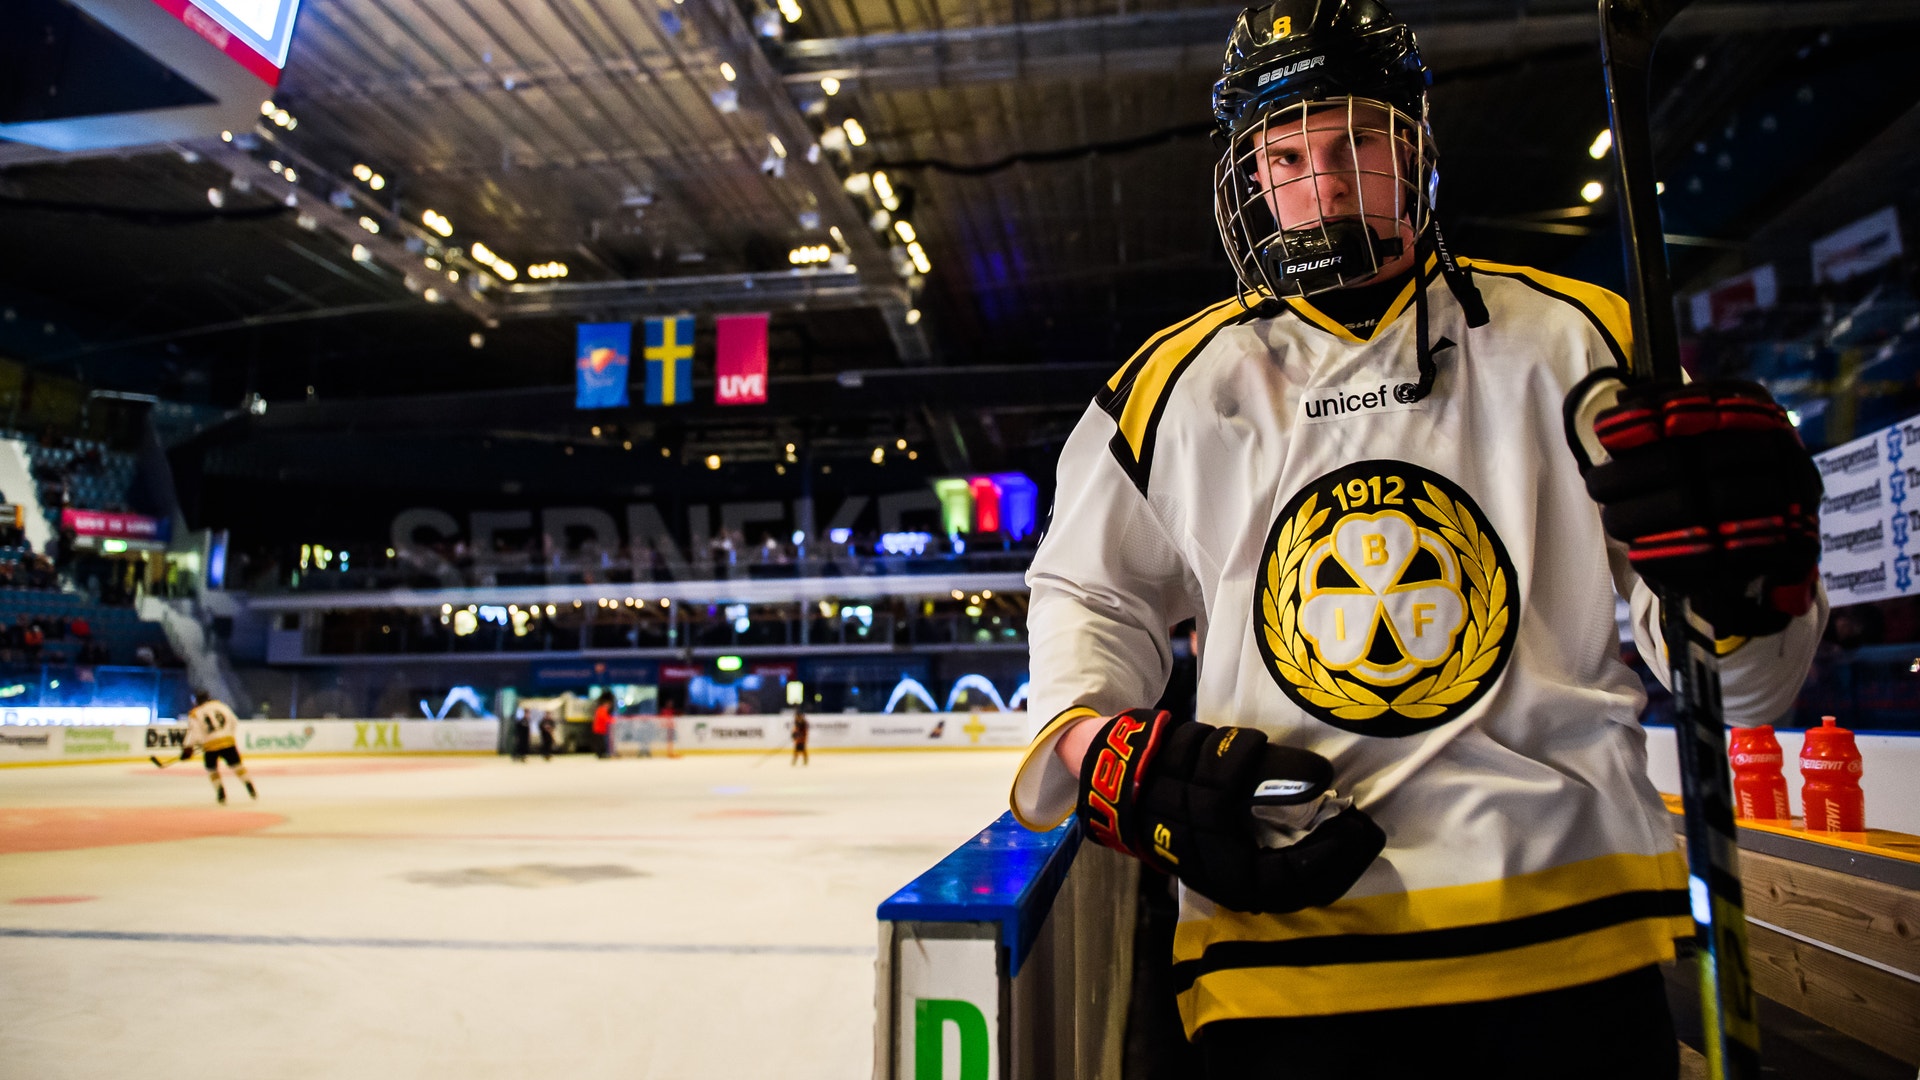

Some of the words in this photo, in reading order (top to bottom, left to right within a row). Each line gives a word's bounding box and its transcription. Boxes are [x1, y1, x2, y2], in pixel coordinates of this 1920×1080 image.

[1272, 15, 1292, 38] 8
[1257, 55, 1325, 87] BAUER
[1434, 221, 1455, 273] BAUER
[1286, 255, 1342, 274] BAUER
[1305, 385, 1387, 418] unicef
[1331, 475, 1406, 511] 1912
[1361, 533, 1389, 567] B
[1335, 607, 1346, 641] I
[1412, 603, 1438, 638] F
[354, 721, 404, 750] XXL
[1803, 759, 1845, 770] ENERVIT
